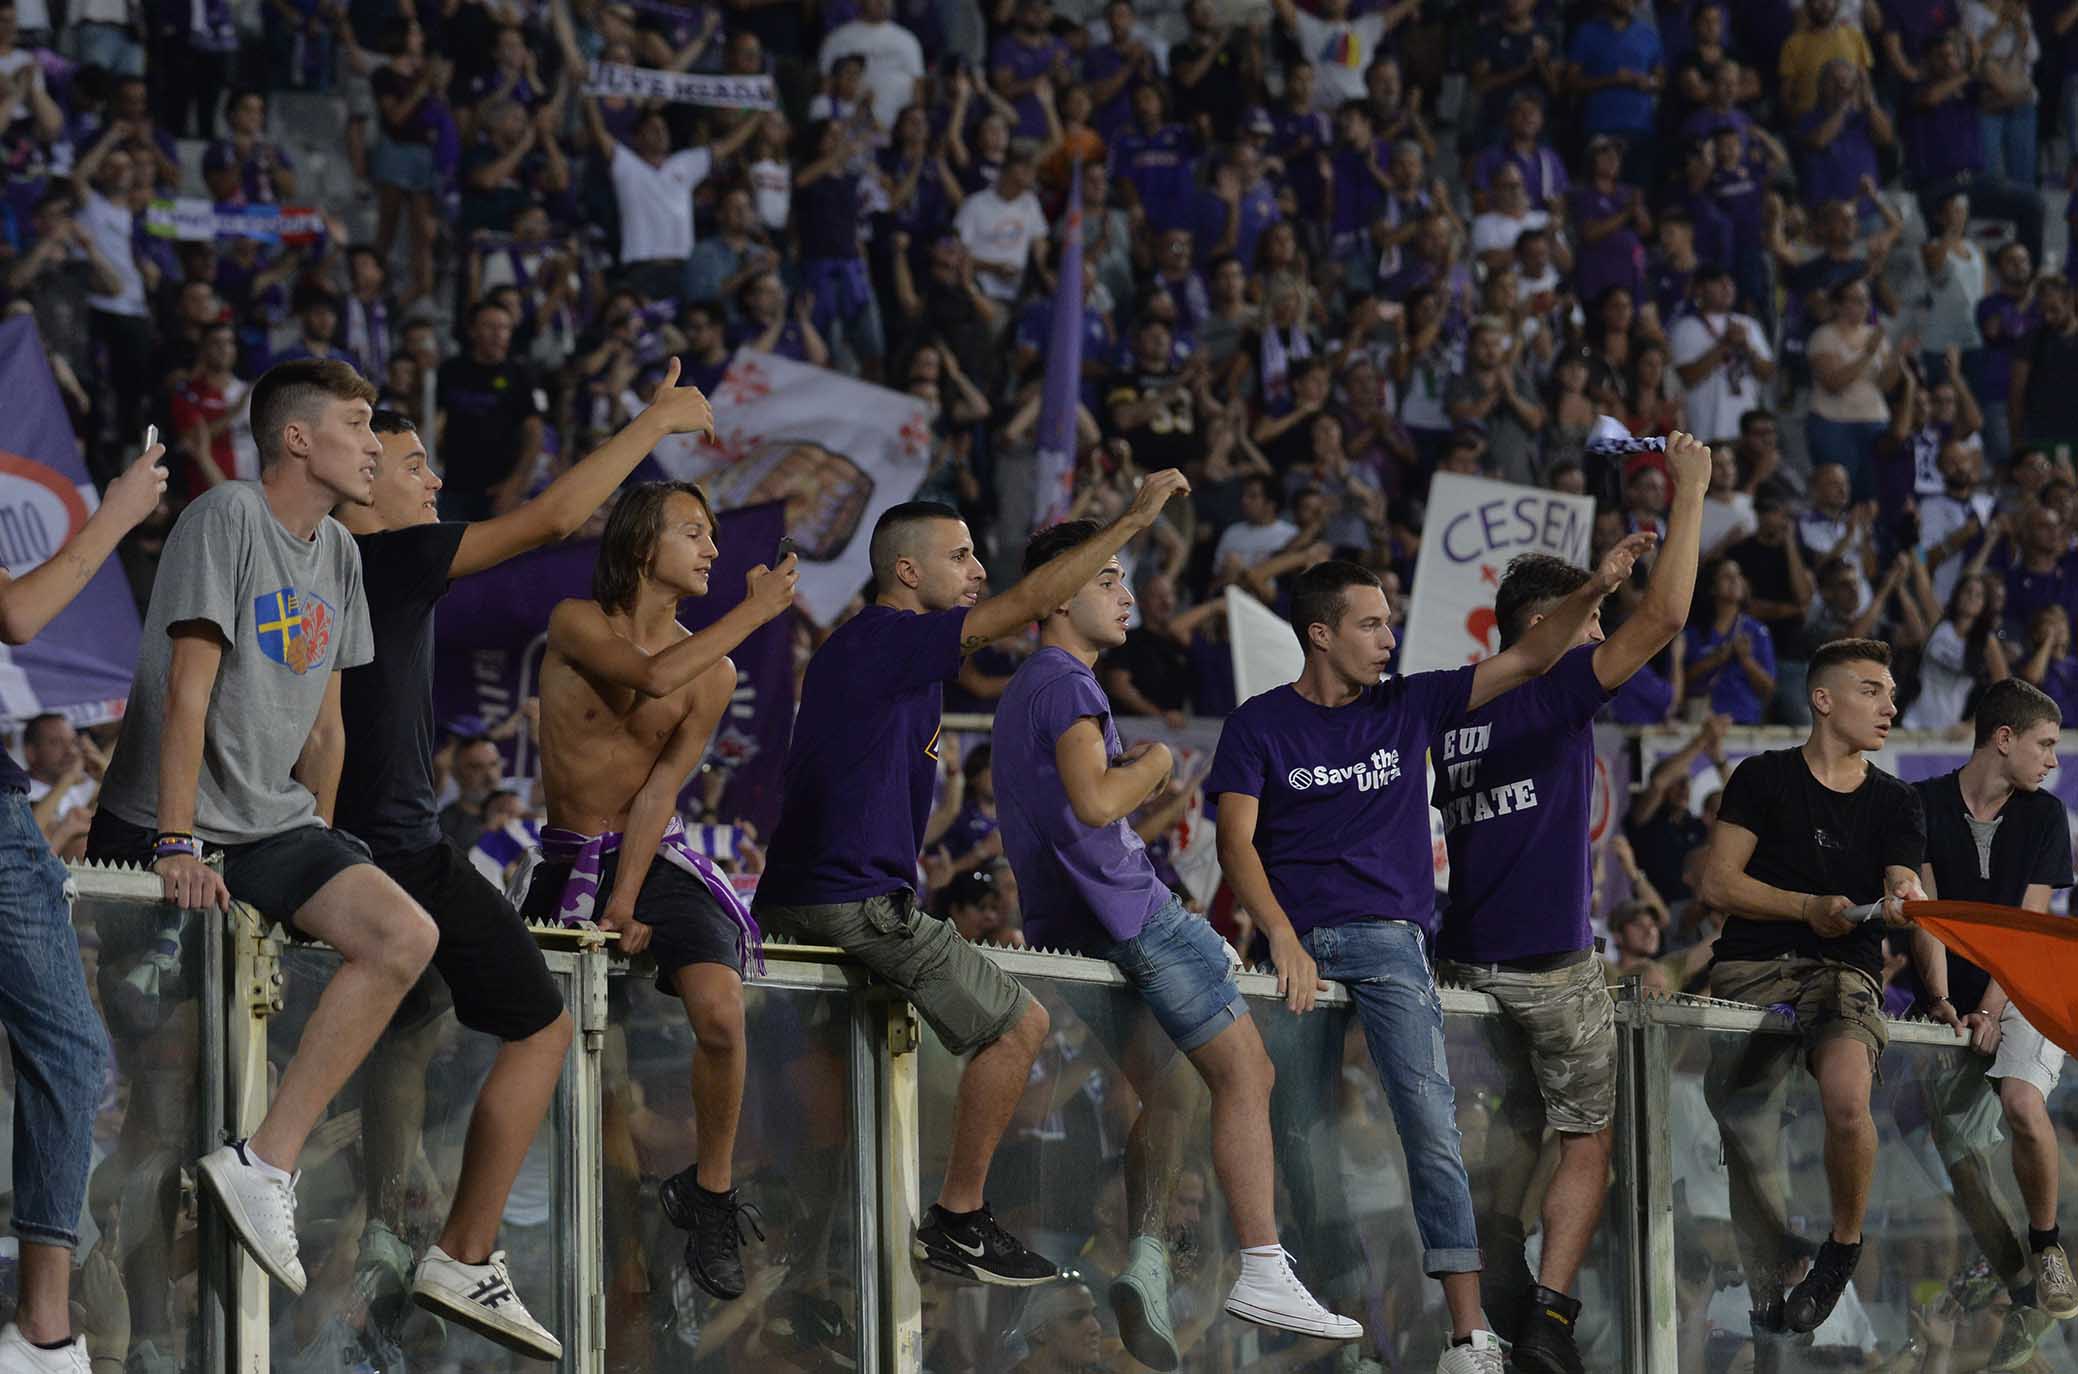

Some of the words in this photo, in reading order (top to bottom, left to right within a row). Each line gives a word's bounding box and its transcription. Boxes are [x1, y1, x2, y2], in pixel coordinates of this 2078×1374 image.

[1459, 722, 1492, 755] UN
[1313, 762, 1367, 786] Save
[1370, 749, 1399, 770] the
